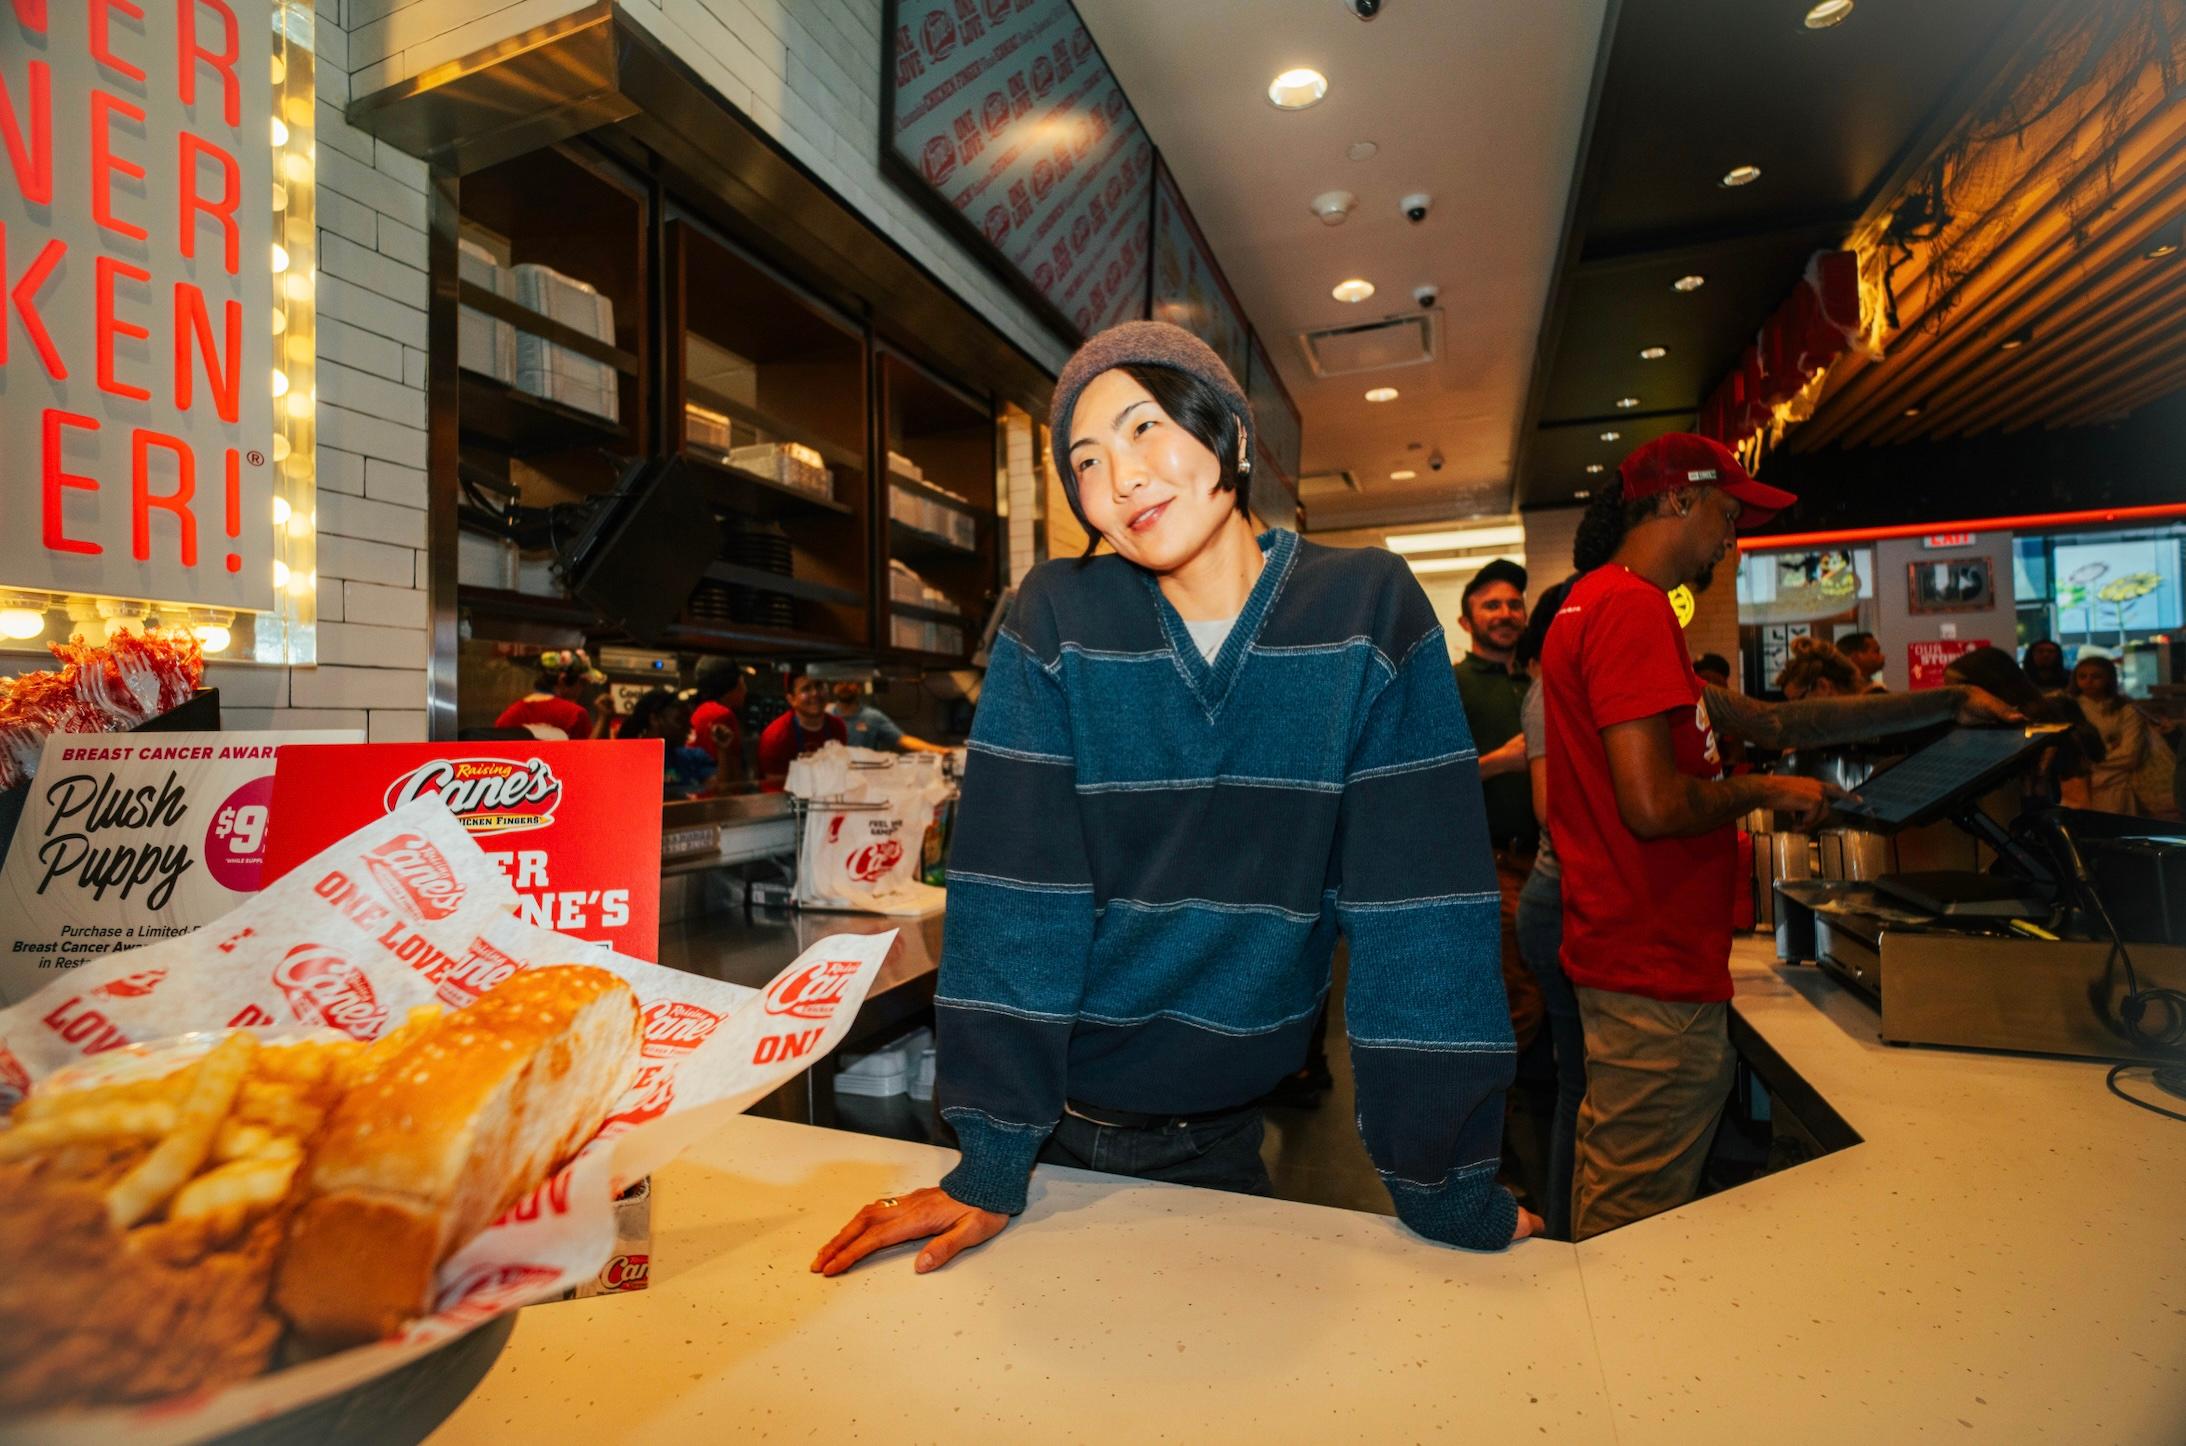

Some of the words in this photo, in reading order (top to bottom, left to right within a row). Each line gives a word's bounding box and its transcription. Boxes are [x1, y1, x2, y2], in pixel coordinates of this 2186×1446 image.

[62, 748, 133, 761] BREAST
[138, 747, 214, 760] CANCER
[456, 763, 513, 778] Raising
[395, 758, 560, 814] Cane's
[46, 770, 188, 836] Plush
[36, 833, 194, 911] Puppy
[61, 925, 122, 938] Purchase
[126, 928, 134, 937] a
[12, 941, 57, 953] Breast
[61, 942, 110, 953] Cancer
[38, 957, 52, 969] in
